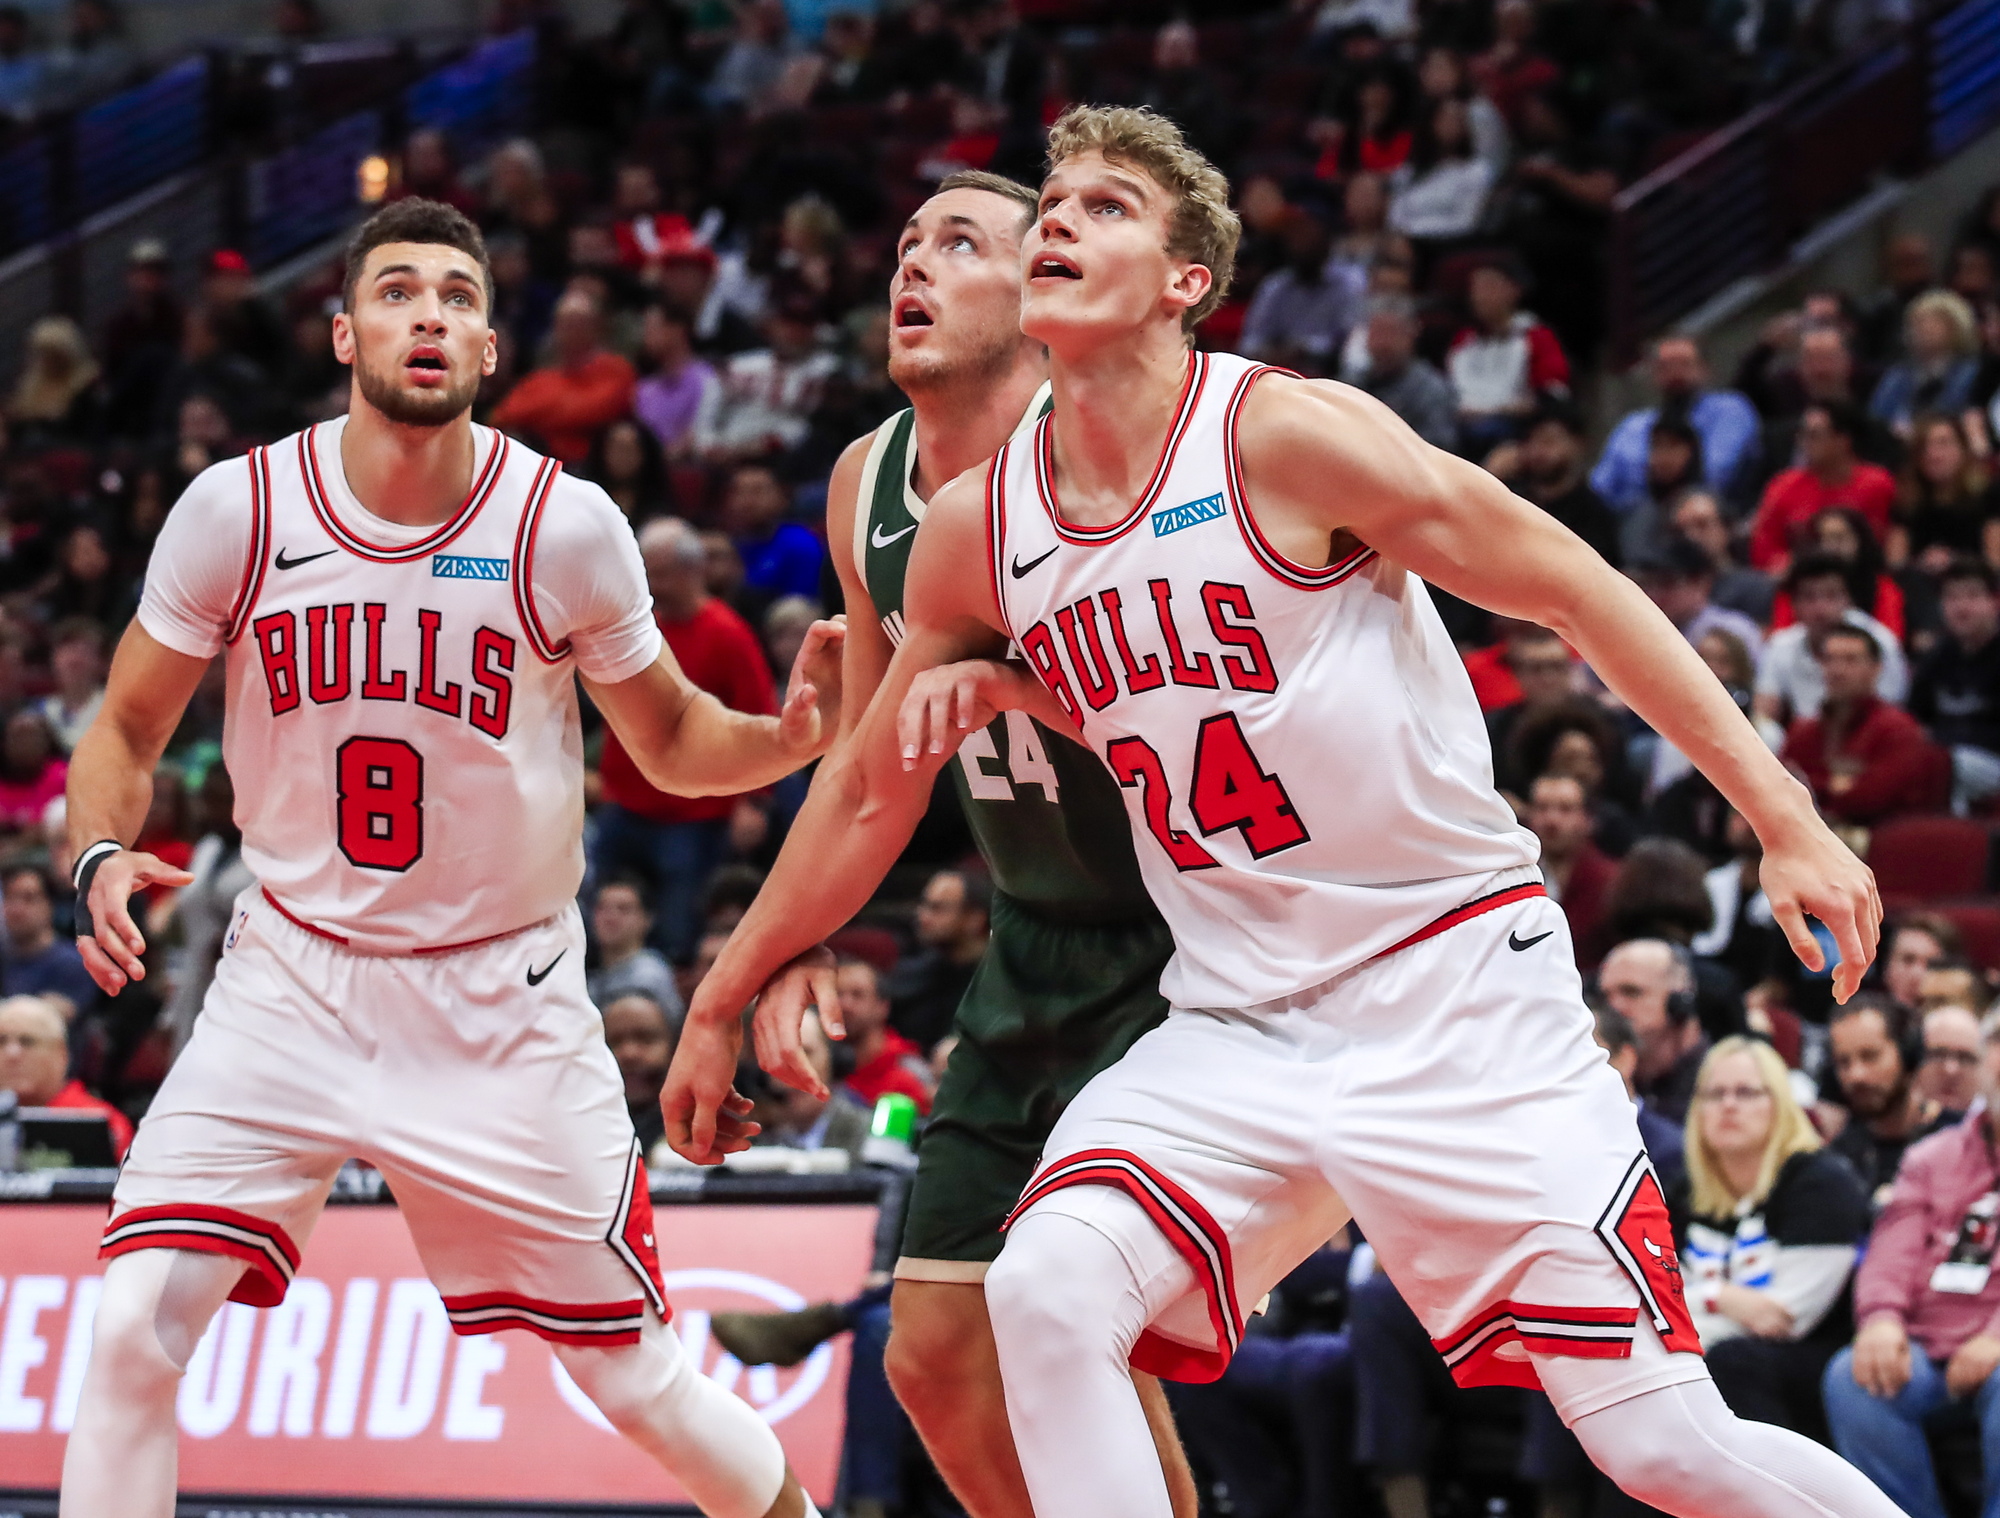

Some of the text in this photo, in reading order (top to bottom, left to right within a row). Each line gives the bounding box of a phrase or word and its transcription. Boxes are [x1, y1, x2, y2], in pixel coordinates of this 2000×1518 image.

[253, 603, 515, 740] BULLS
[1021, 578, 1279, 733] BULLS
[336, 736, 424, 872] 8
[1106, 711, 1311, 872] 24
